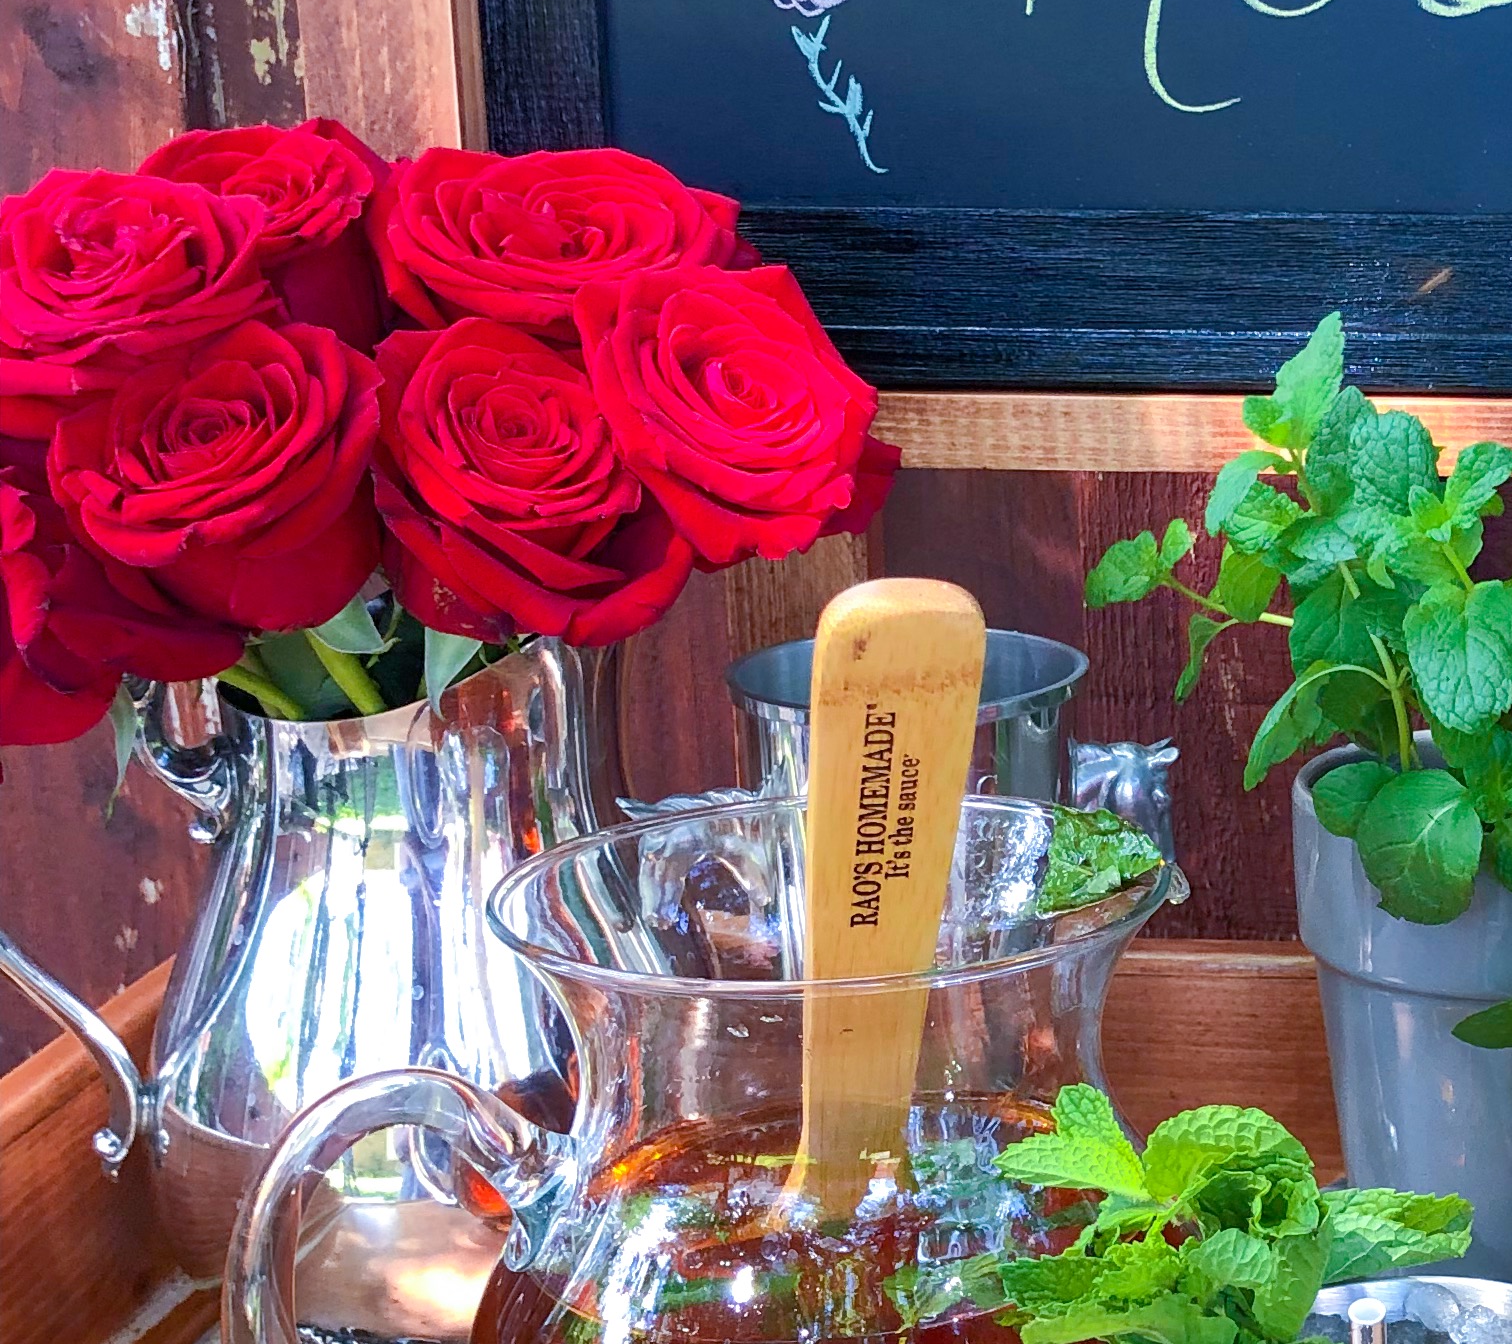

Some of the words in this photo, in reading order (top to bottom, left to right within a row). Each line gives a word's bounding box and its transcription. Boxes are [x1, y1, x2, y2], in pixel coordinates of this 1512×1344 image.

[898, 757, 921, 811] sauce
[888, 816, 915, 846] the
[885, 851, 911, 880] It's
[850, 862, 883, 928] RAO'S
